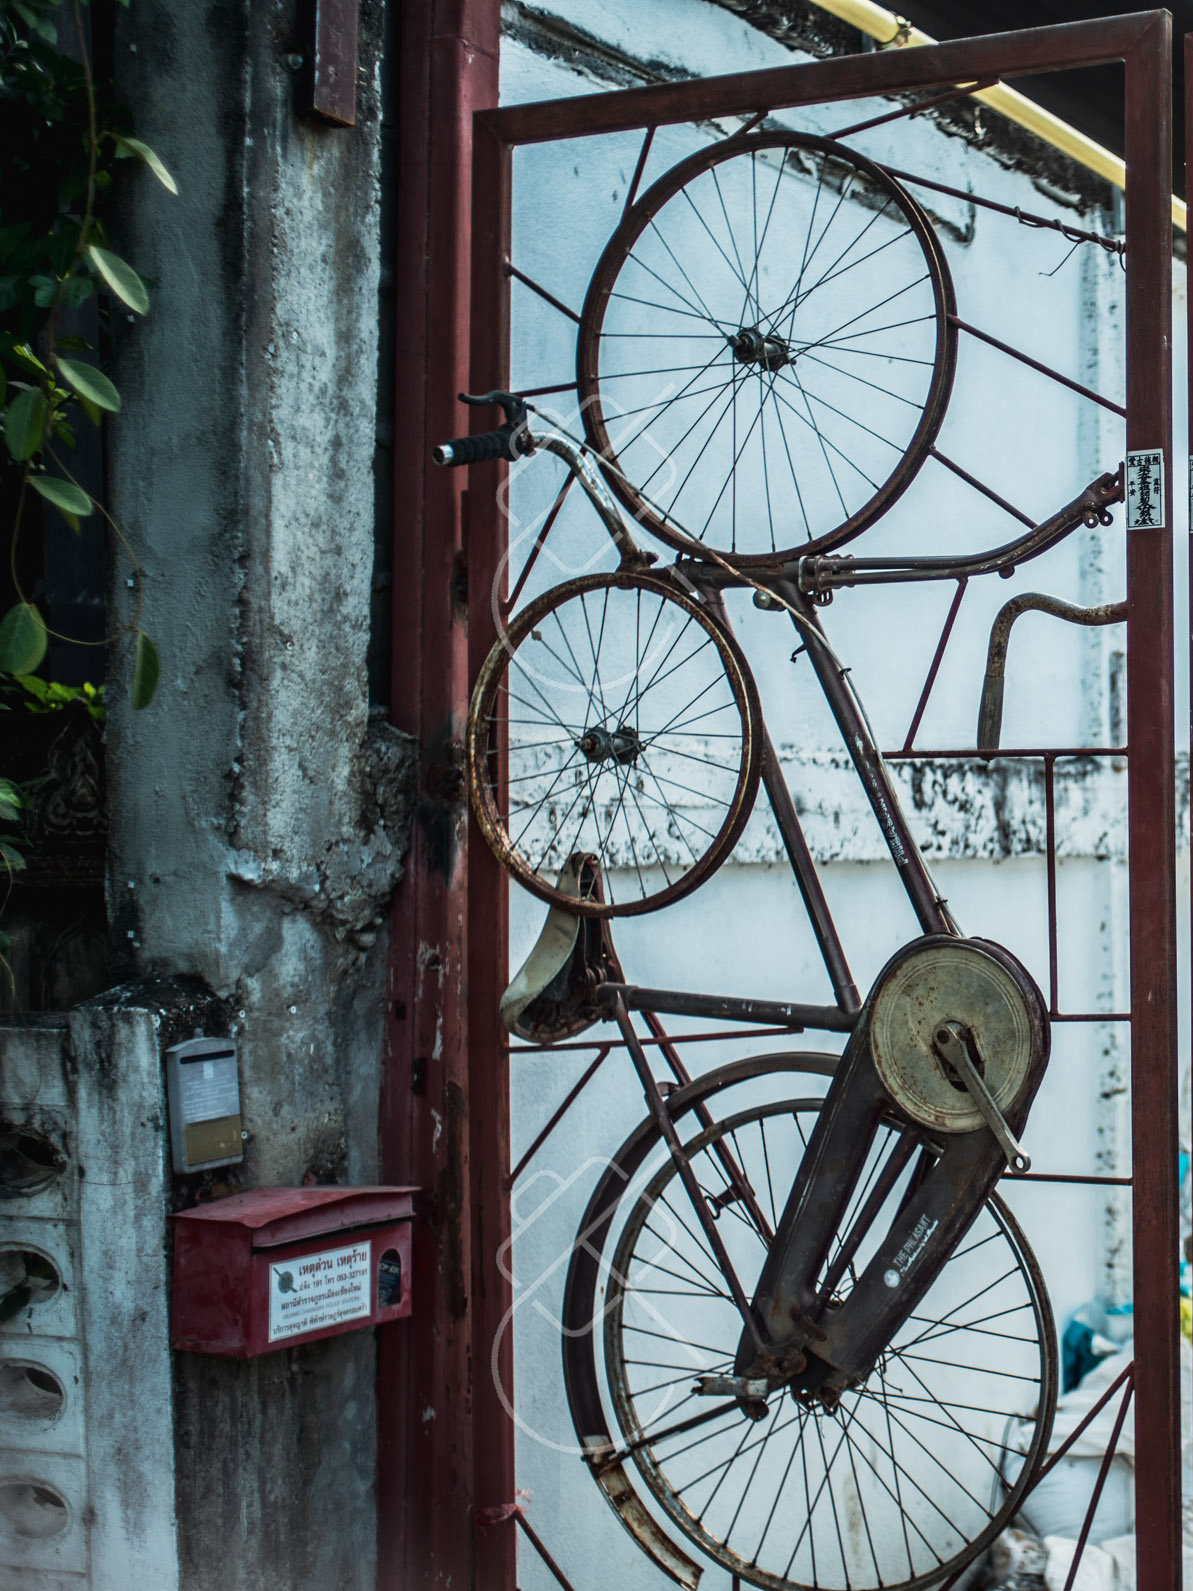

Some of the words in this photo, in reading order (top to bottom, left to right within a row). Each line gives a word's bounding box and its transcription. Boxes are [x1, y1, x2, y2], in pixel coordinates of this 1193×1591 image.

[298, 1258, 333, 1278] เหตุด่วน
[336, 1248, 367, 1269] เหตุร้าย
[893, 1249, 909, 1267] THE
